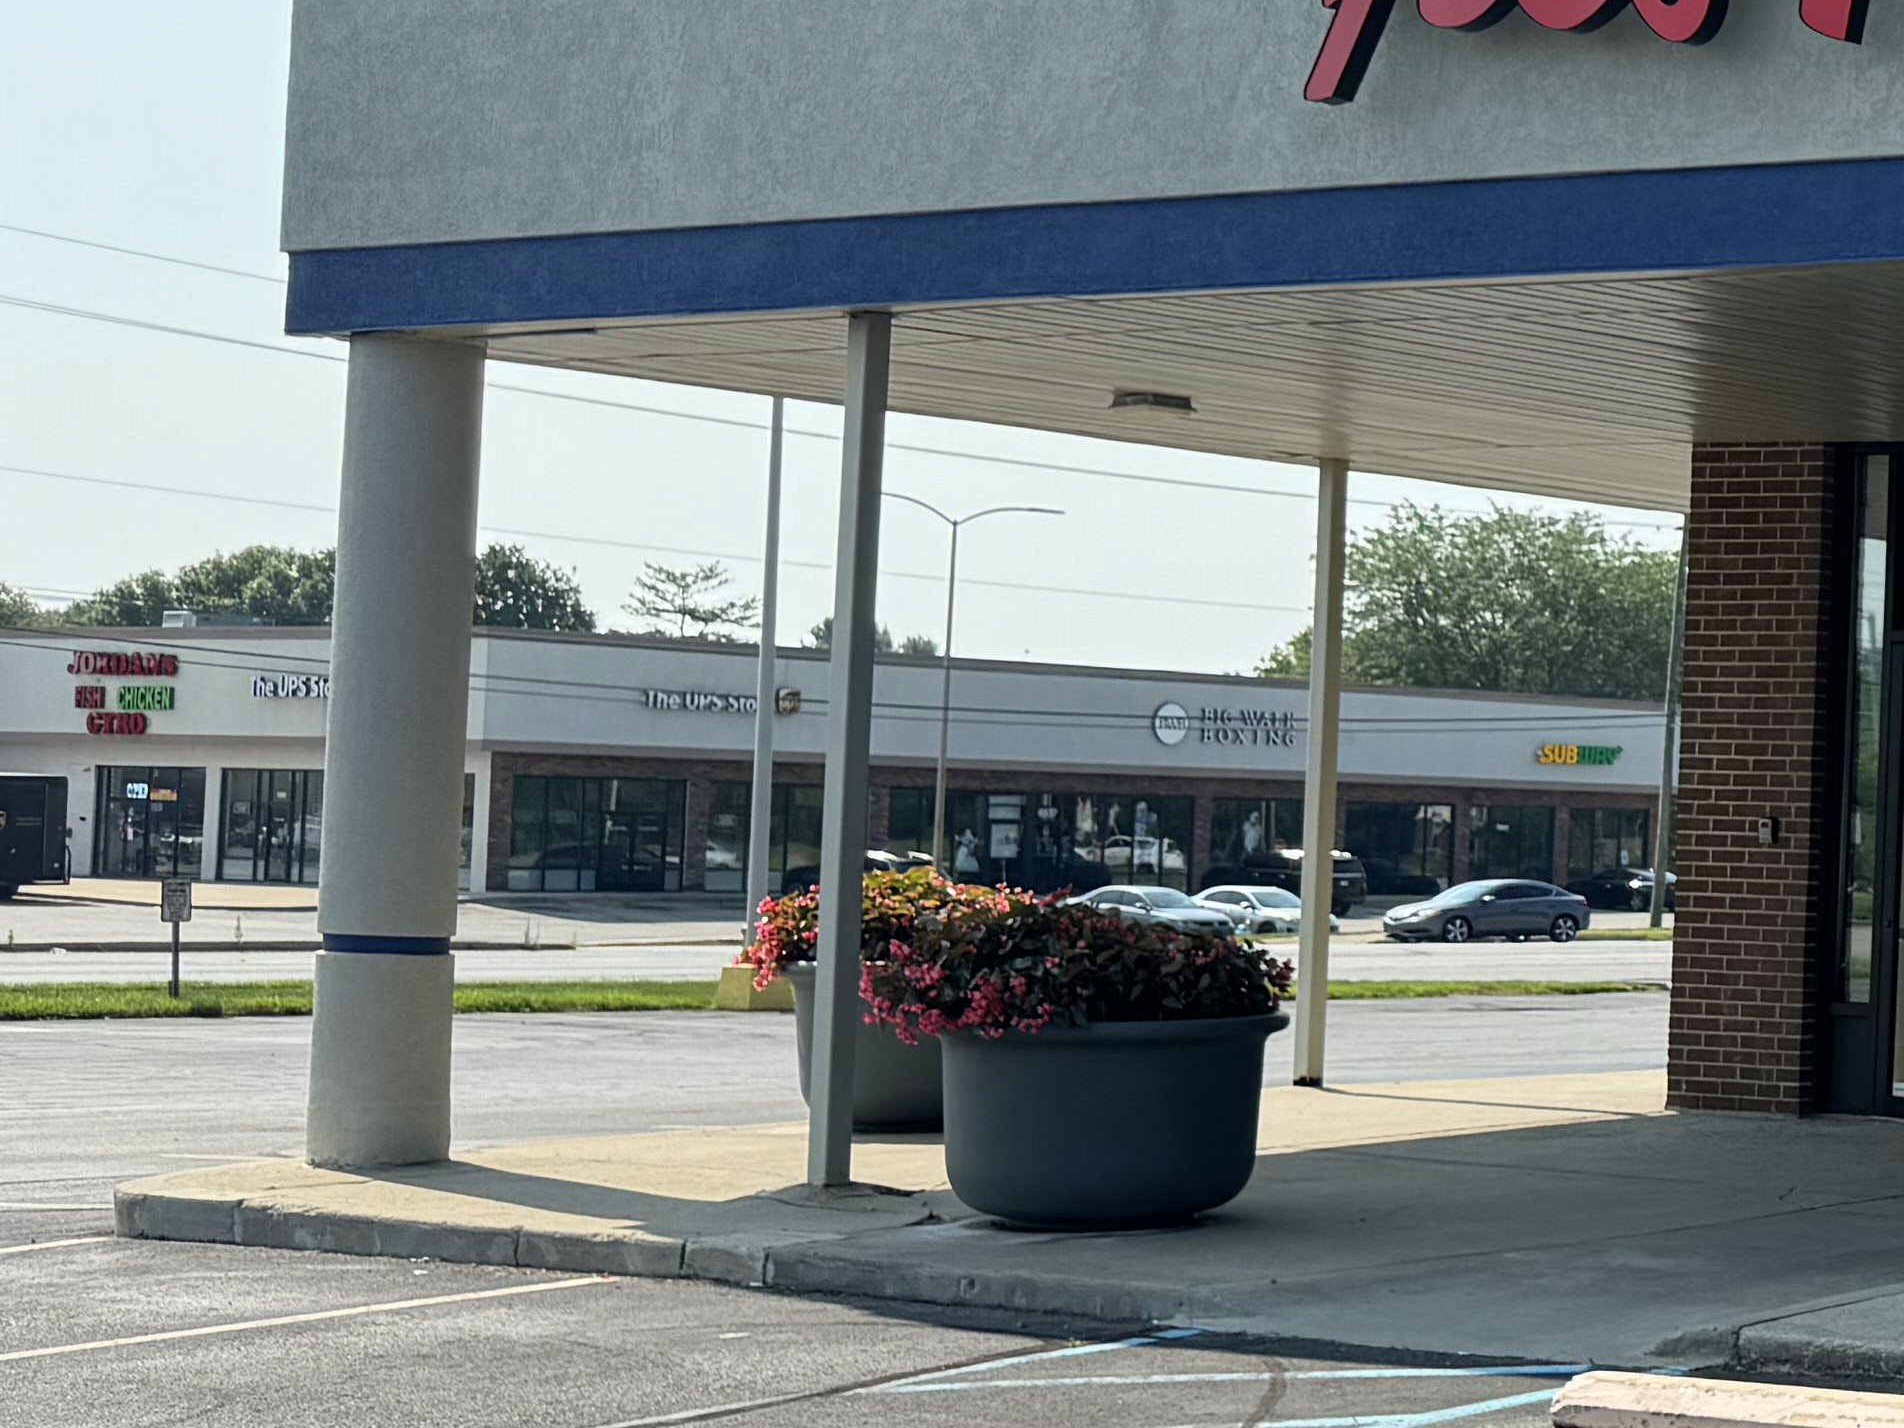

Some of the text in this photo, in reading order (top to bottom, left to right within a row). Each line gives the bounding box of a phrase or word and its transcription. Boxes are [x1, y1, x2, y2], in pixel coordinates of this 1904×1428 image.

[252, 674, 330, 698] The UPS Sto
[75, 686, 175, 710] FISH CHICKEN
[645, 690, 681, 712] The
[684, 692, 723, 712] UPS
[729, 694, 758, 713] Sto
[1201, 729, 1297, 747] BOXING
[1535, 743, 1624, 765] SUBWAY
